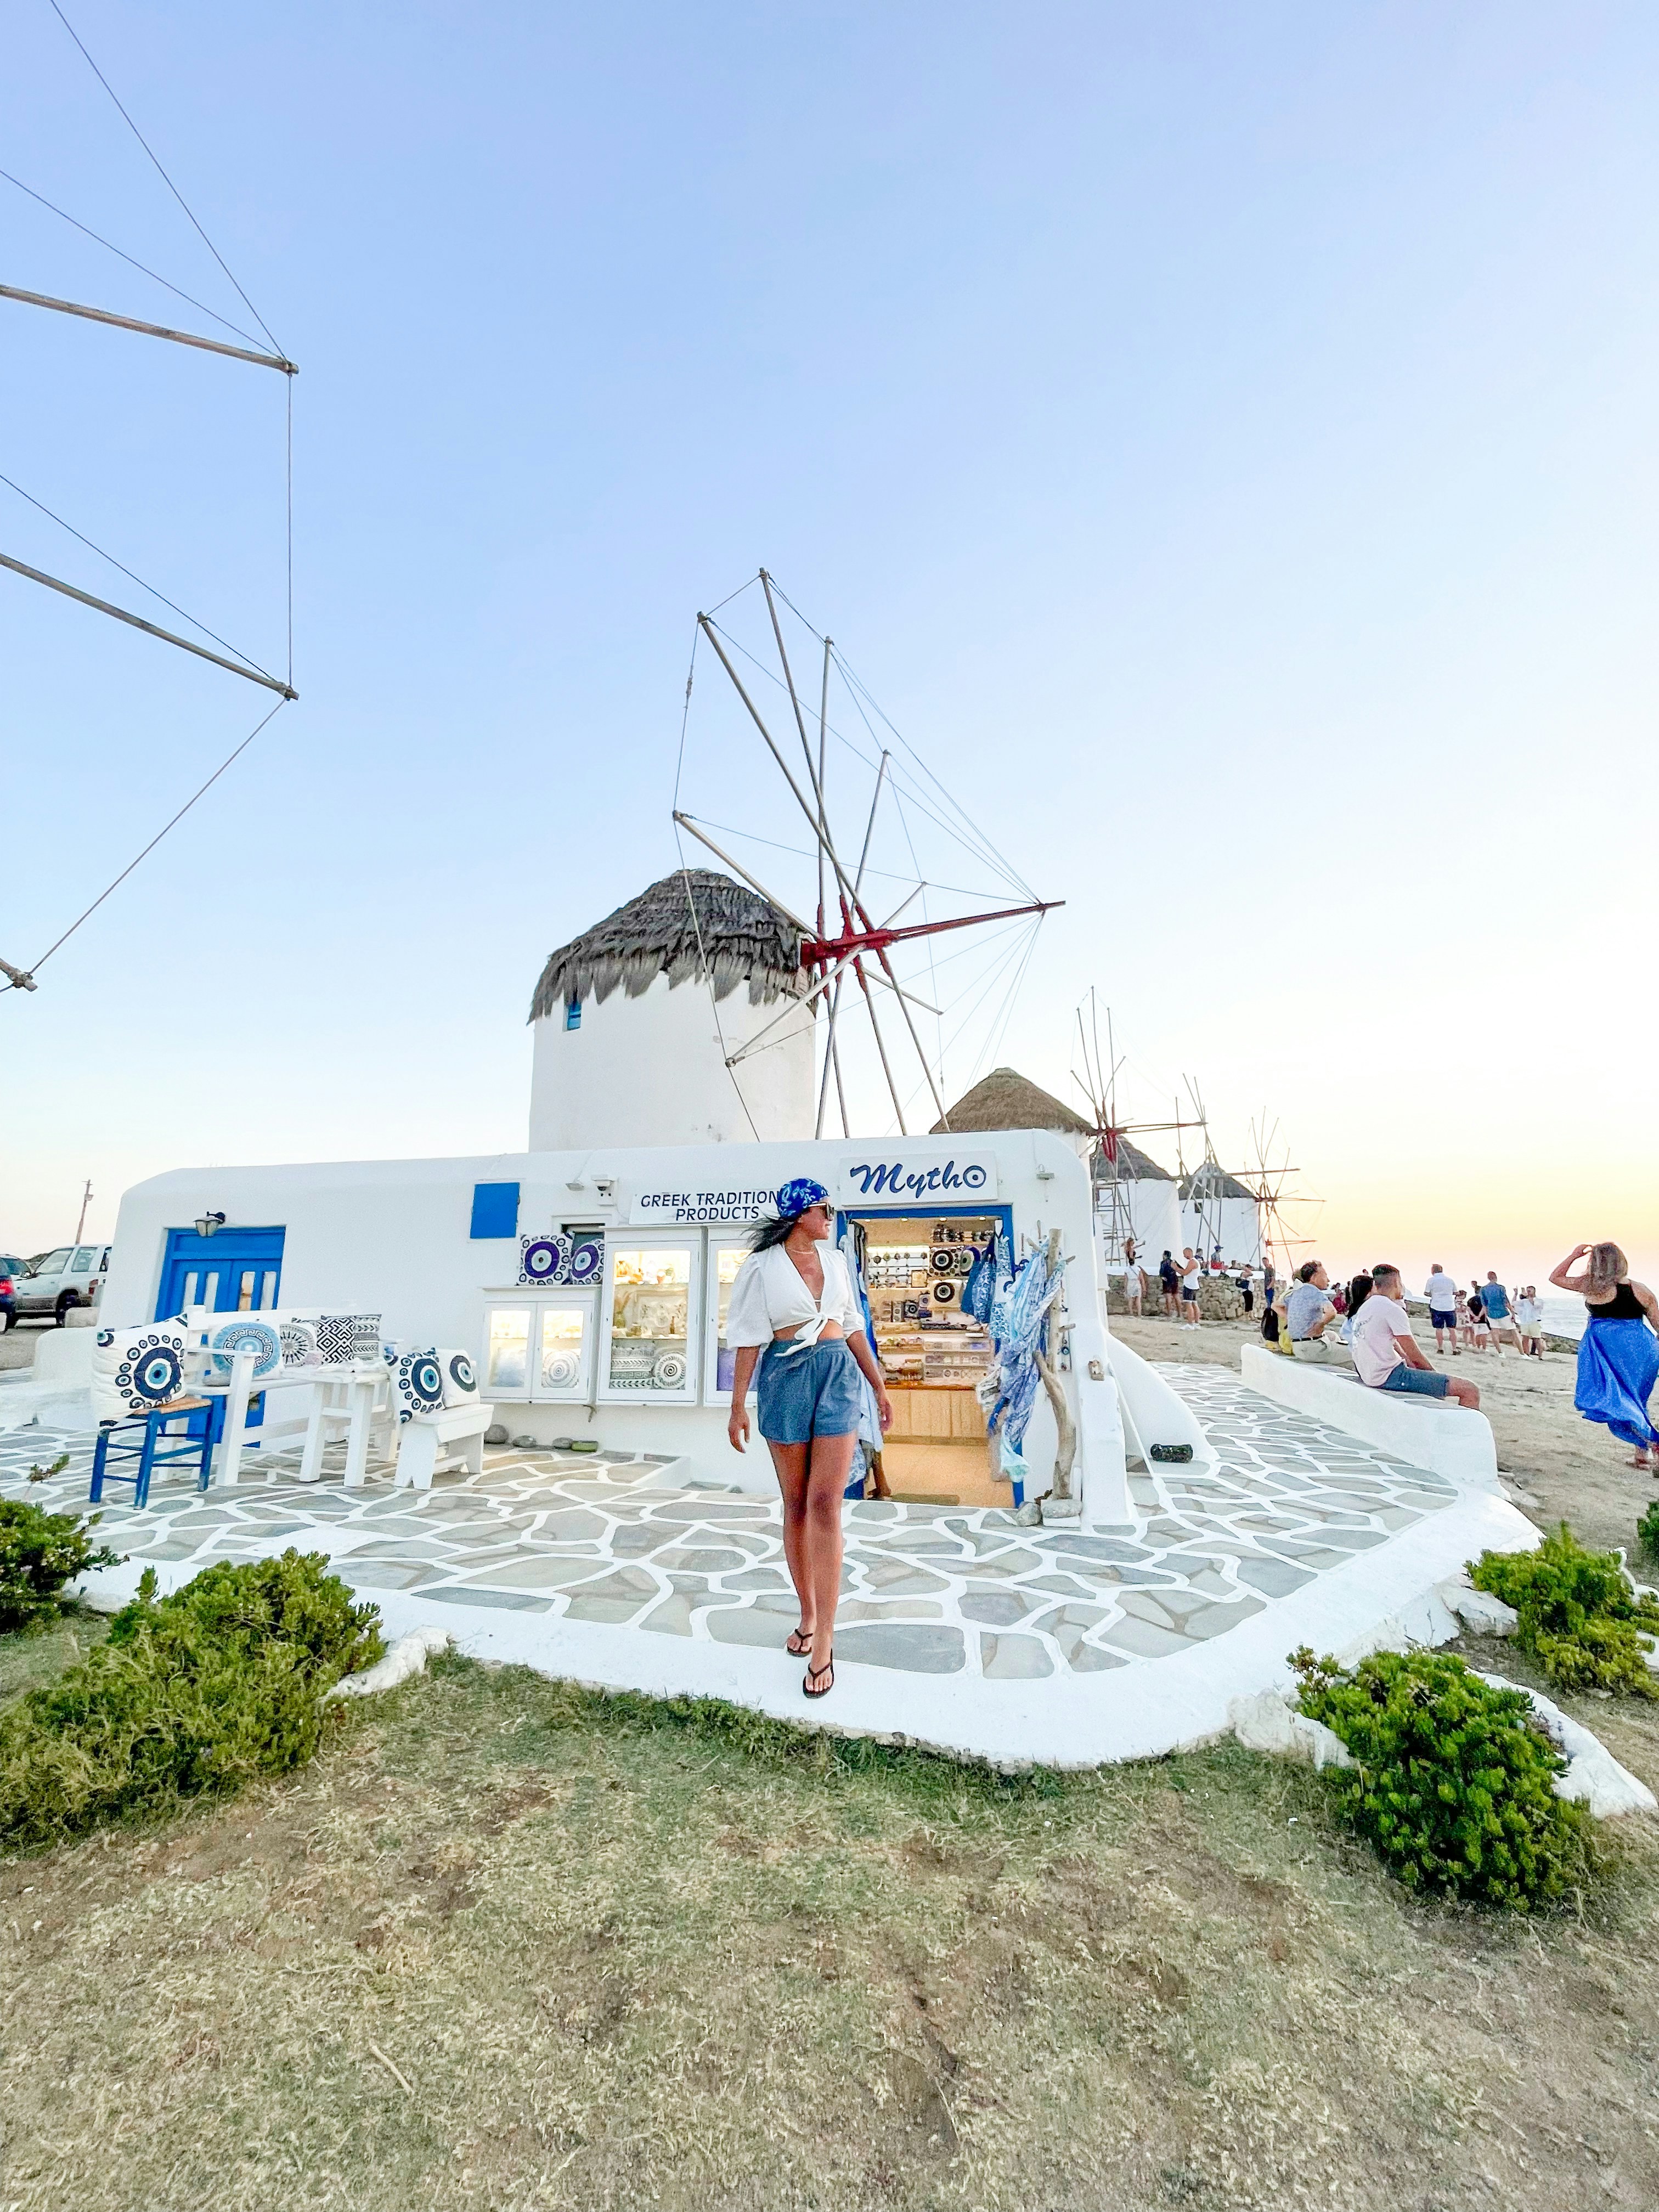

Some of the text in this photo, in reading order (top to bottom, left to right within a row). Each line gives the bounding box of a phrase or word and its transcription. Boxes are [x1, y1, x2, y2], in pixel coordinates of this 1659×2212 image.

[641, 1191, 780, 1207] GREEK TRADITION
[675, 1206, 760, 1221] PRODUCTS
